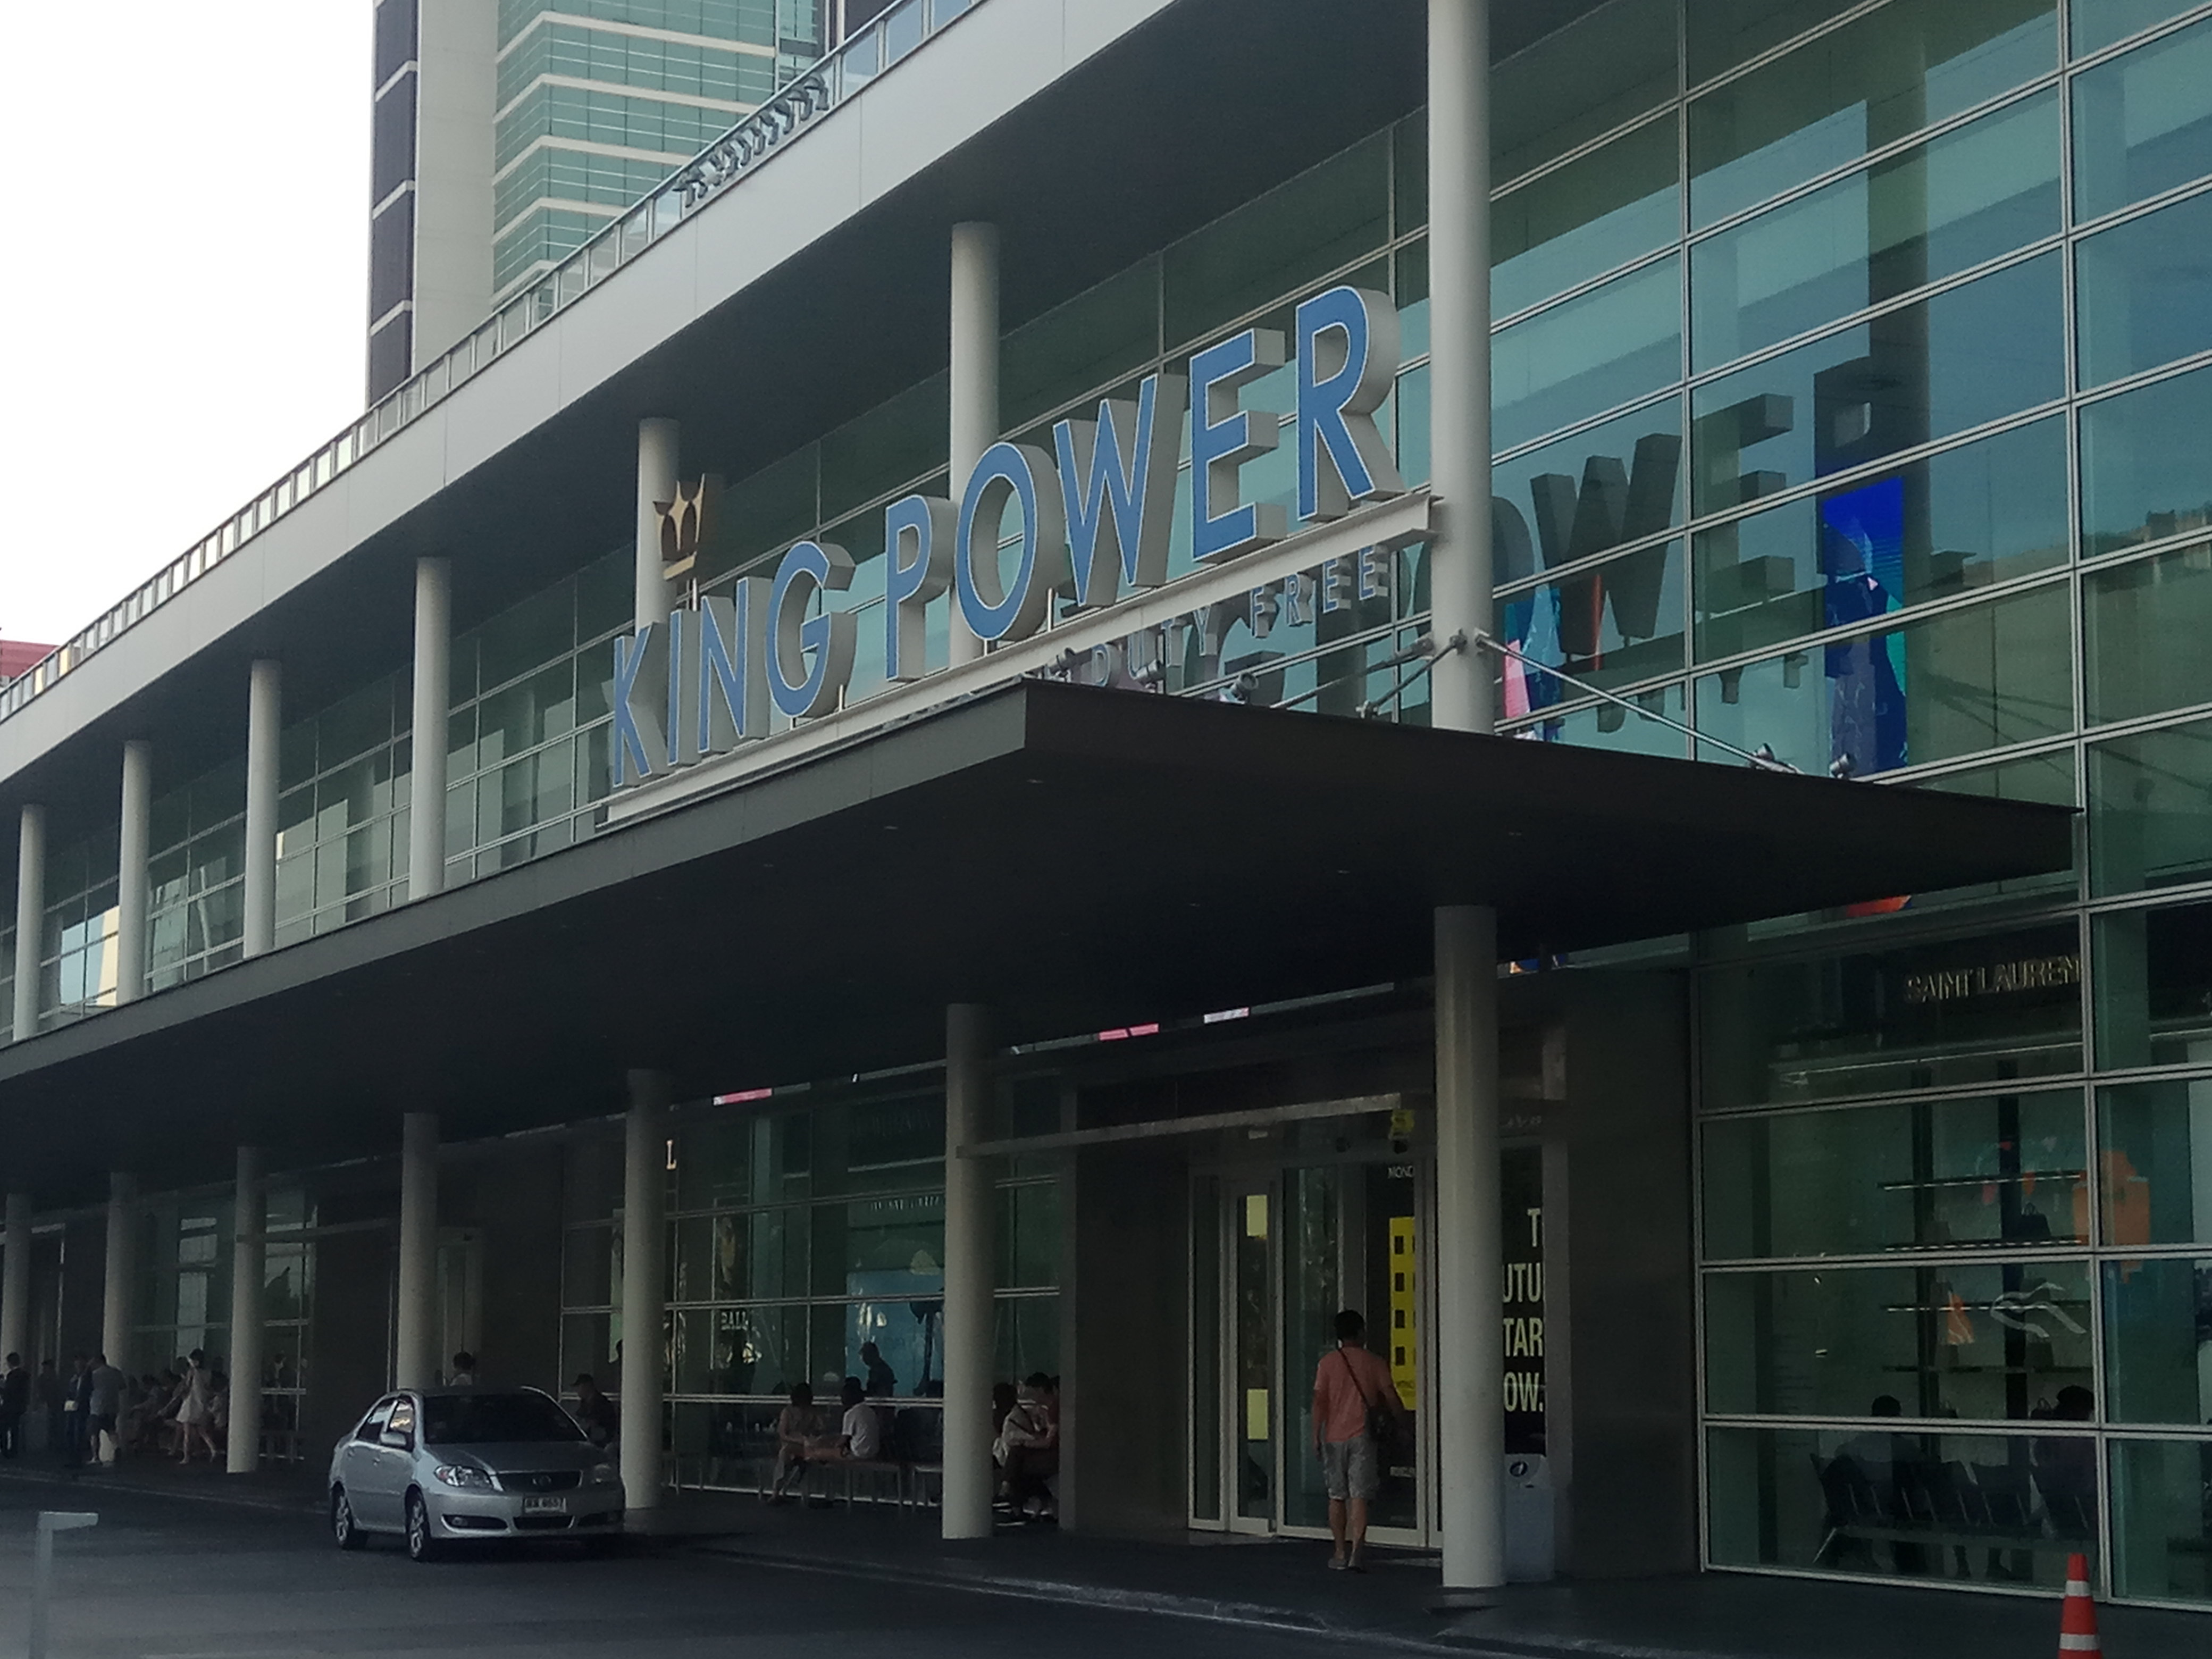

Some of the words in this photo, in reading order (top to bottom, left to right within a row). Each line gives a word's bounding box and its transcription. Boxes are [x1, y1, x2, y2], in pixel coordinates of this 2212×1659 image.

[613, 540, 856, 787] KING
[885, 285, 1403, 682] POWER
[1092, 606, 1215, 686] DUTY
[1250, 545, 1388, 638] FREE
[1905, 969, 1974, 1003] SAINT
